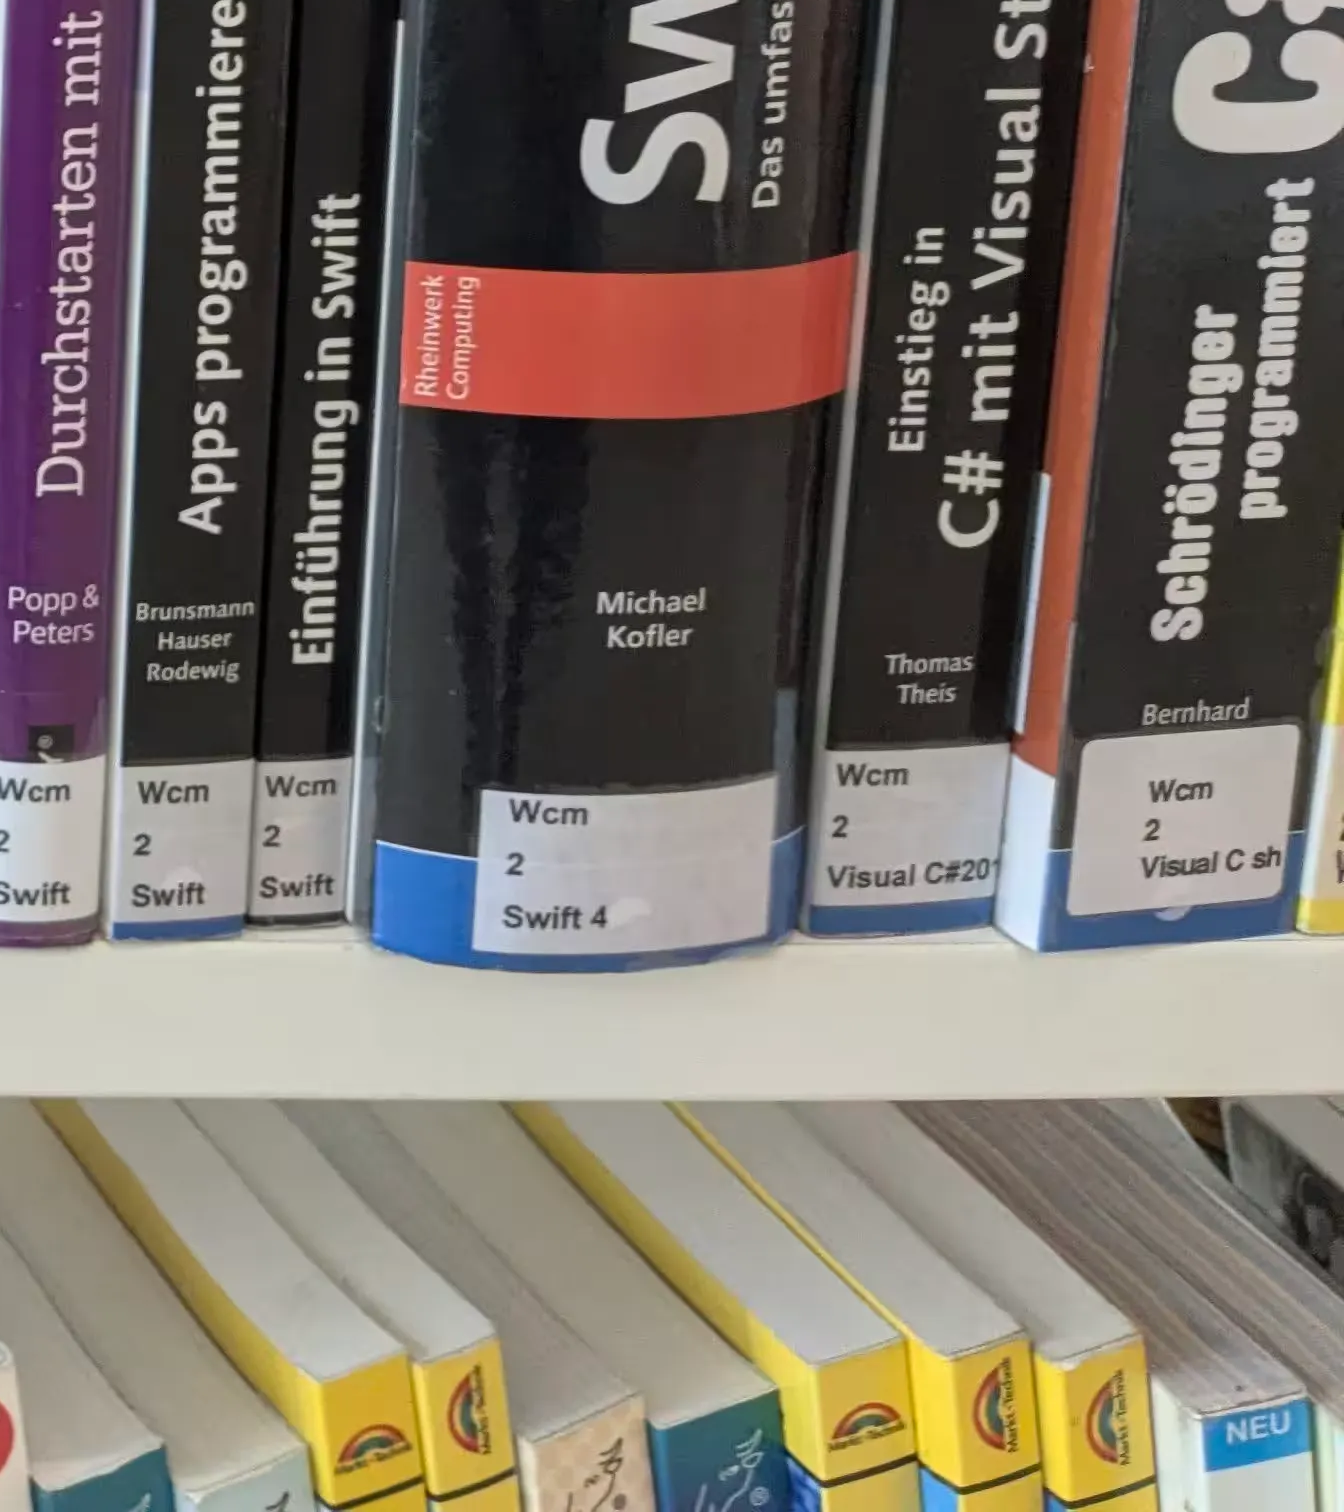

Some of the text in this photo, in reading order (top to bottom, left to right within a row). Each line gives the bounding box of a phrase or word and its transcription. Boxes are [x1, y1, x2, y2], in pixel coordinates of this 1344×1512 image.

[51, 8, 105, 116] mit
[972, 85, 1043, 295] Visual
[35, 122, 100, 498] Durchstarten
[413, 273, 444, 397] Rheinwerk
[445, 273, 482, 401] Computing
[888, 265, 951, 453] Einstieg
[961, 310, 1018, 423] mit
[1238, 176, 1316, 520] programmiert
[177, 400, 240, 535] Apps
[290, 192, 362, 665] Einführung in Swift
[1150, 305, 1239, 643] Schrödinger
[938, 448, 1004, 549] C#
[7, 586, 100, 616] Popp &
[11, 619, 95, 645] Peters
[1141, 698, 1250, 727] Bernhard
[1226, 1410, 1291, 1445] NEU
